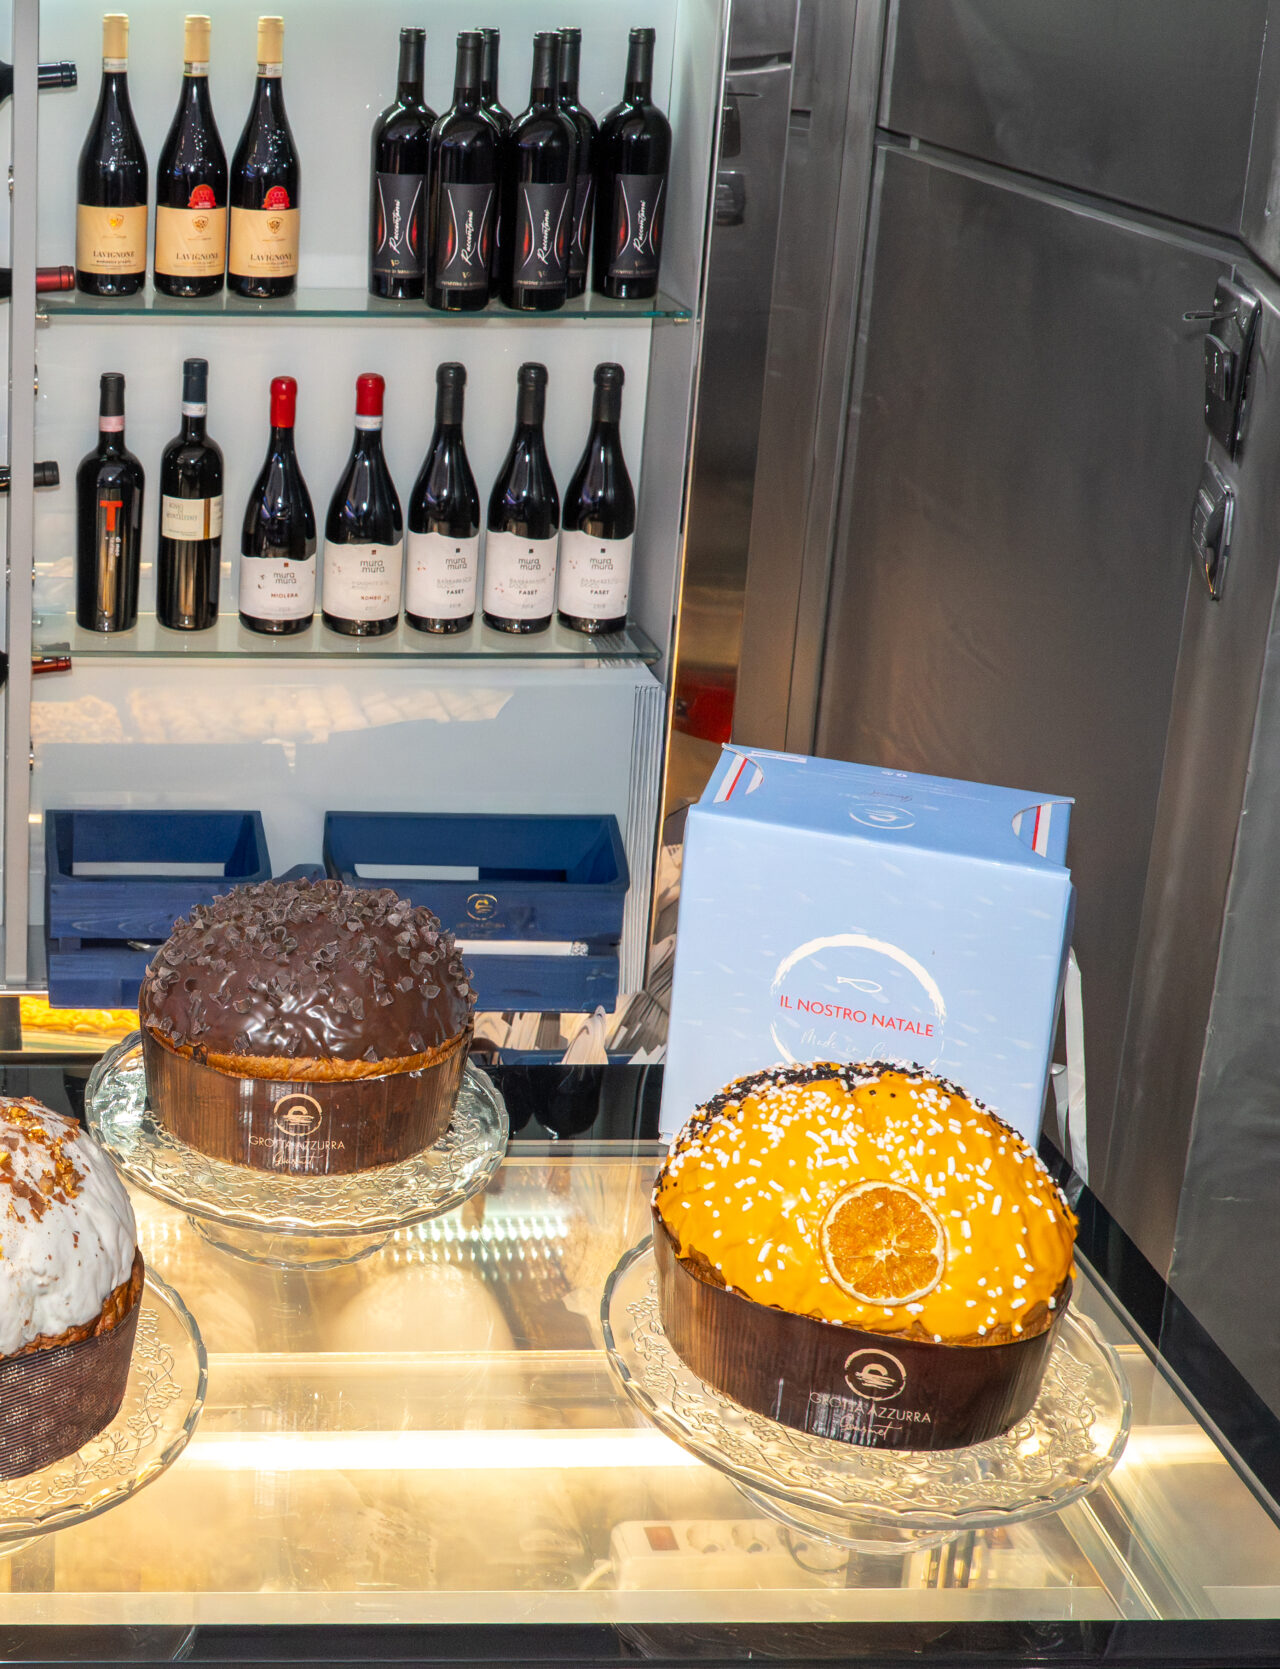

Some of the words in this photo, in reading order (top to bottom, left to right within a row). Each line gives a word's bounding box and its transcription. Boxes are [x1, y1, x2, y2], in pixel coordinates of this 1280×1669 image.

[360, 559, 384, 567] mura
[445, 557, 467, 565] mura
[591, 563, 614, 571] mura
[273, 571, 295, 579] mura
[780, 994, 793, 1009] IL
[796, 998, 867, 1023] NOSTRO
[871, 1013, 935, 1038] NATALE
[248, 1135, 292, 1150] GROTTA
[294, 1140, 346, 1152] AZZURRA
[809, 1391, 865, 1415] GROTTA
[867, 1403, 932, 1424] AZZURRA
